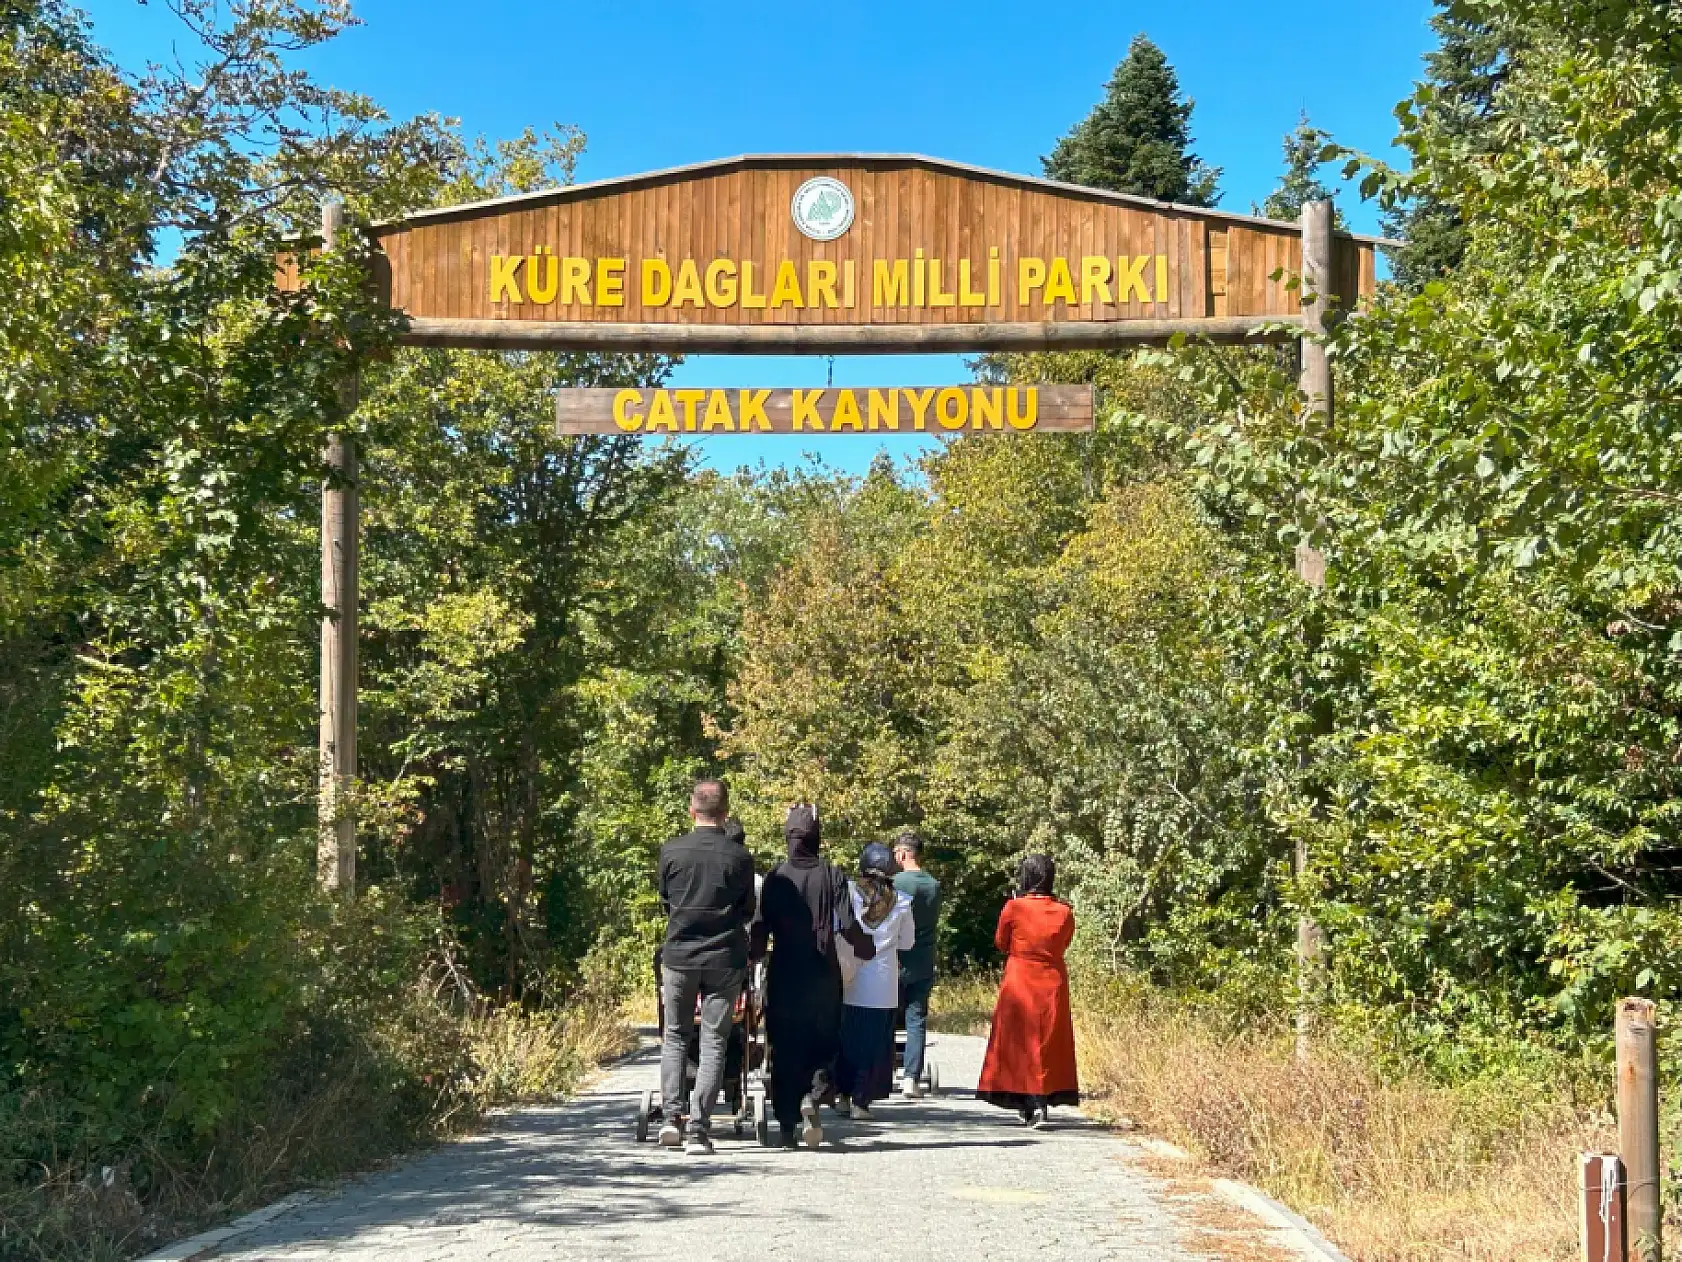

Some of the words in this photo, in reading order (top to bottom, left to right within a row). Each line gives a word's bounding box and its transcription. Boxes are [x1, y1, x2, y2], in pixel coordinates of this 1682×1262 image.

[488, 244, 625, 307] KÜRE
[873, 246, 1001, 308] MİLLİ
[1018, 253, 1168, 306] PARKI
[790, 385, 1039, 431] KANYONU
